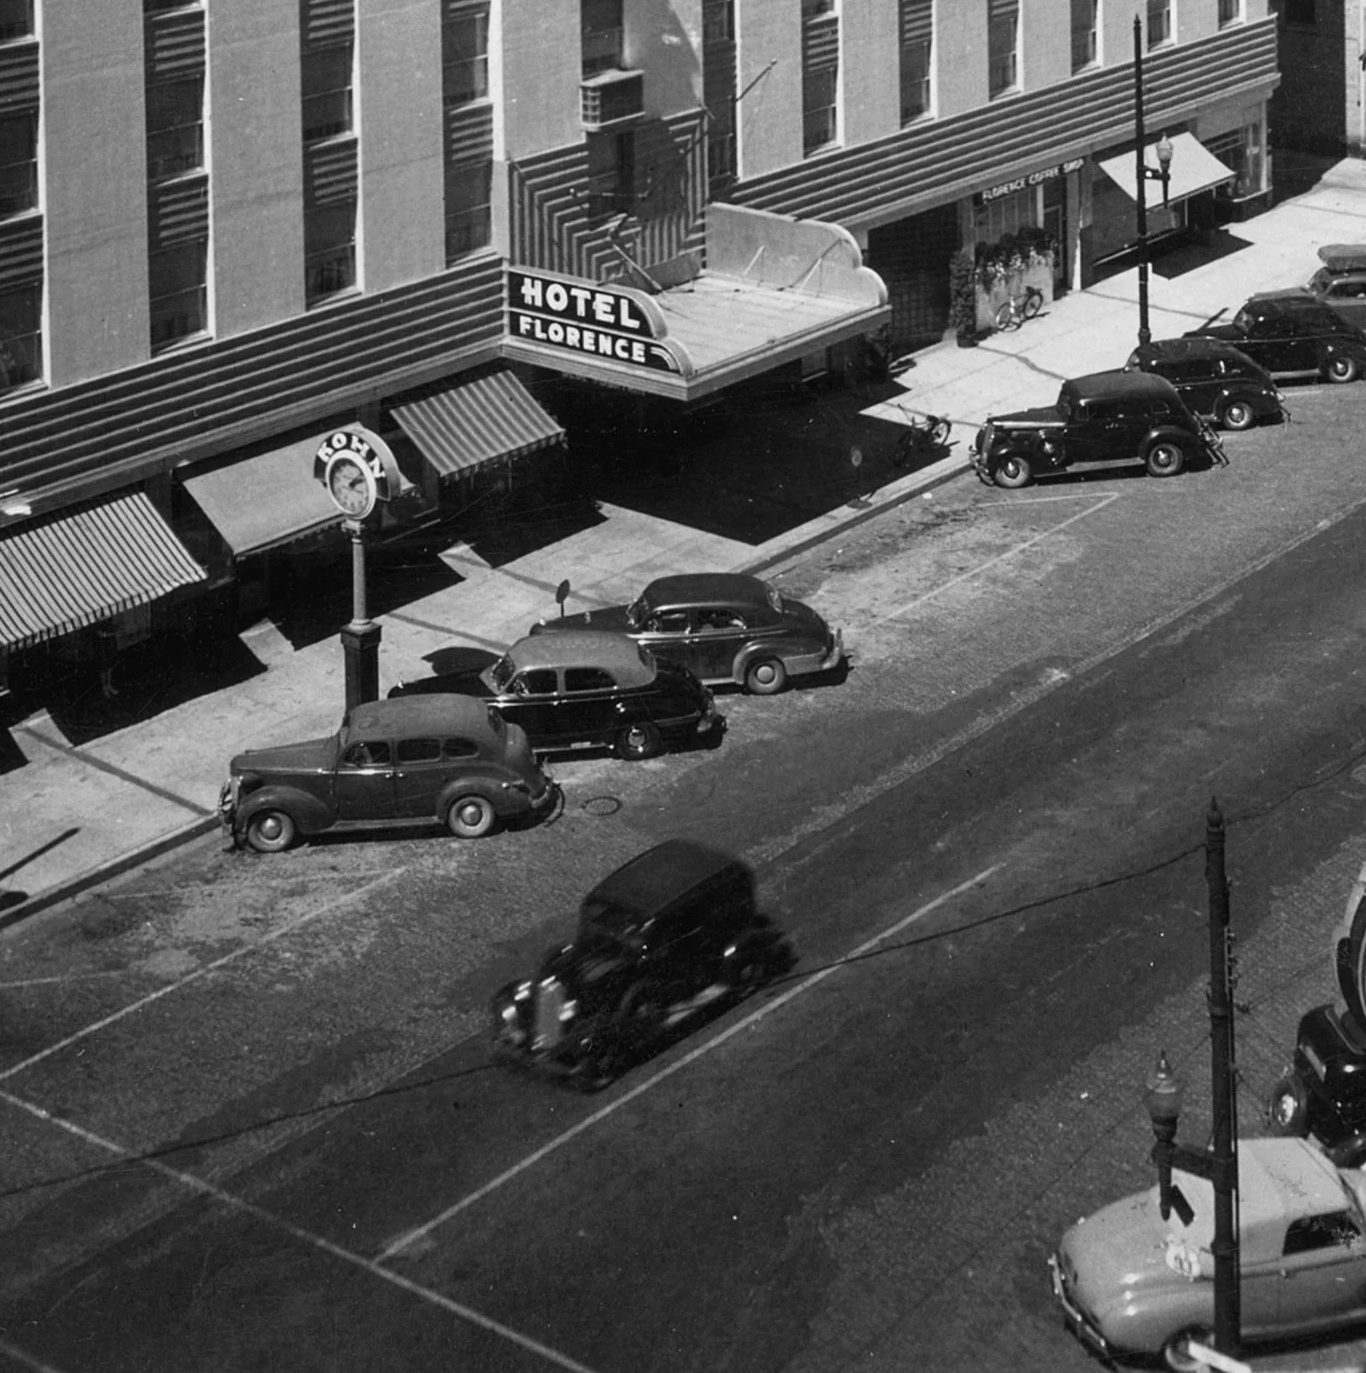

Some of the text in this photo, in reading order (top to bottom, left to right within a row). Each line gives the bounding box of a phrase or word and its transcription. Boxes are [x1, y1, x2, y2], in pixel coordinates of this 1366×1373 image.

[521, 277, 641, 330] HOTEL
[519, 315, 646, 364] FLORENCE
[317, 432, 386, 478] KOHN
